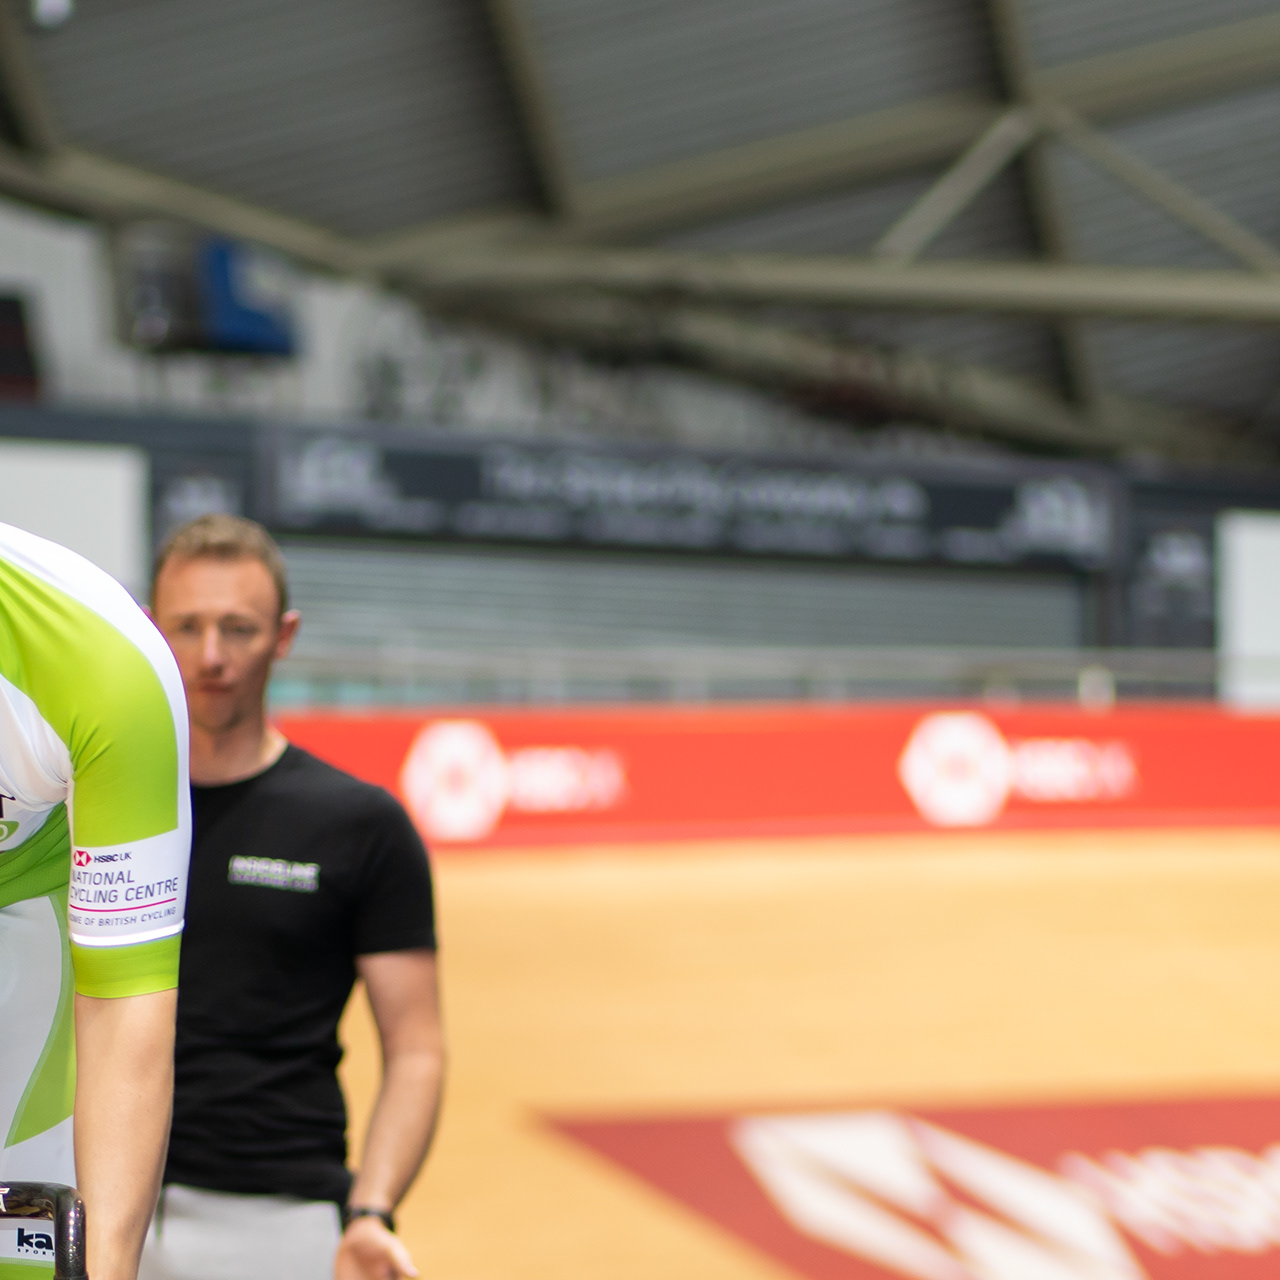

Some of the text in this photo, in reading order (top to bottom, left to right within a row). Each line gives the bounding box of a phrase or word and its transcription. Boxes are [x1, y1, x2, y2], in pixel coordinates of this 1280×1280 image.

[94, 853, 119, 863] HSBC
[125, 877, 179, 901] CENTRE
[98, 916, 137, 927] BRITISH
[141, 906, 176, 922] CYCLING
